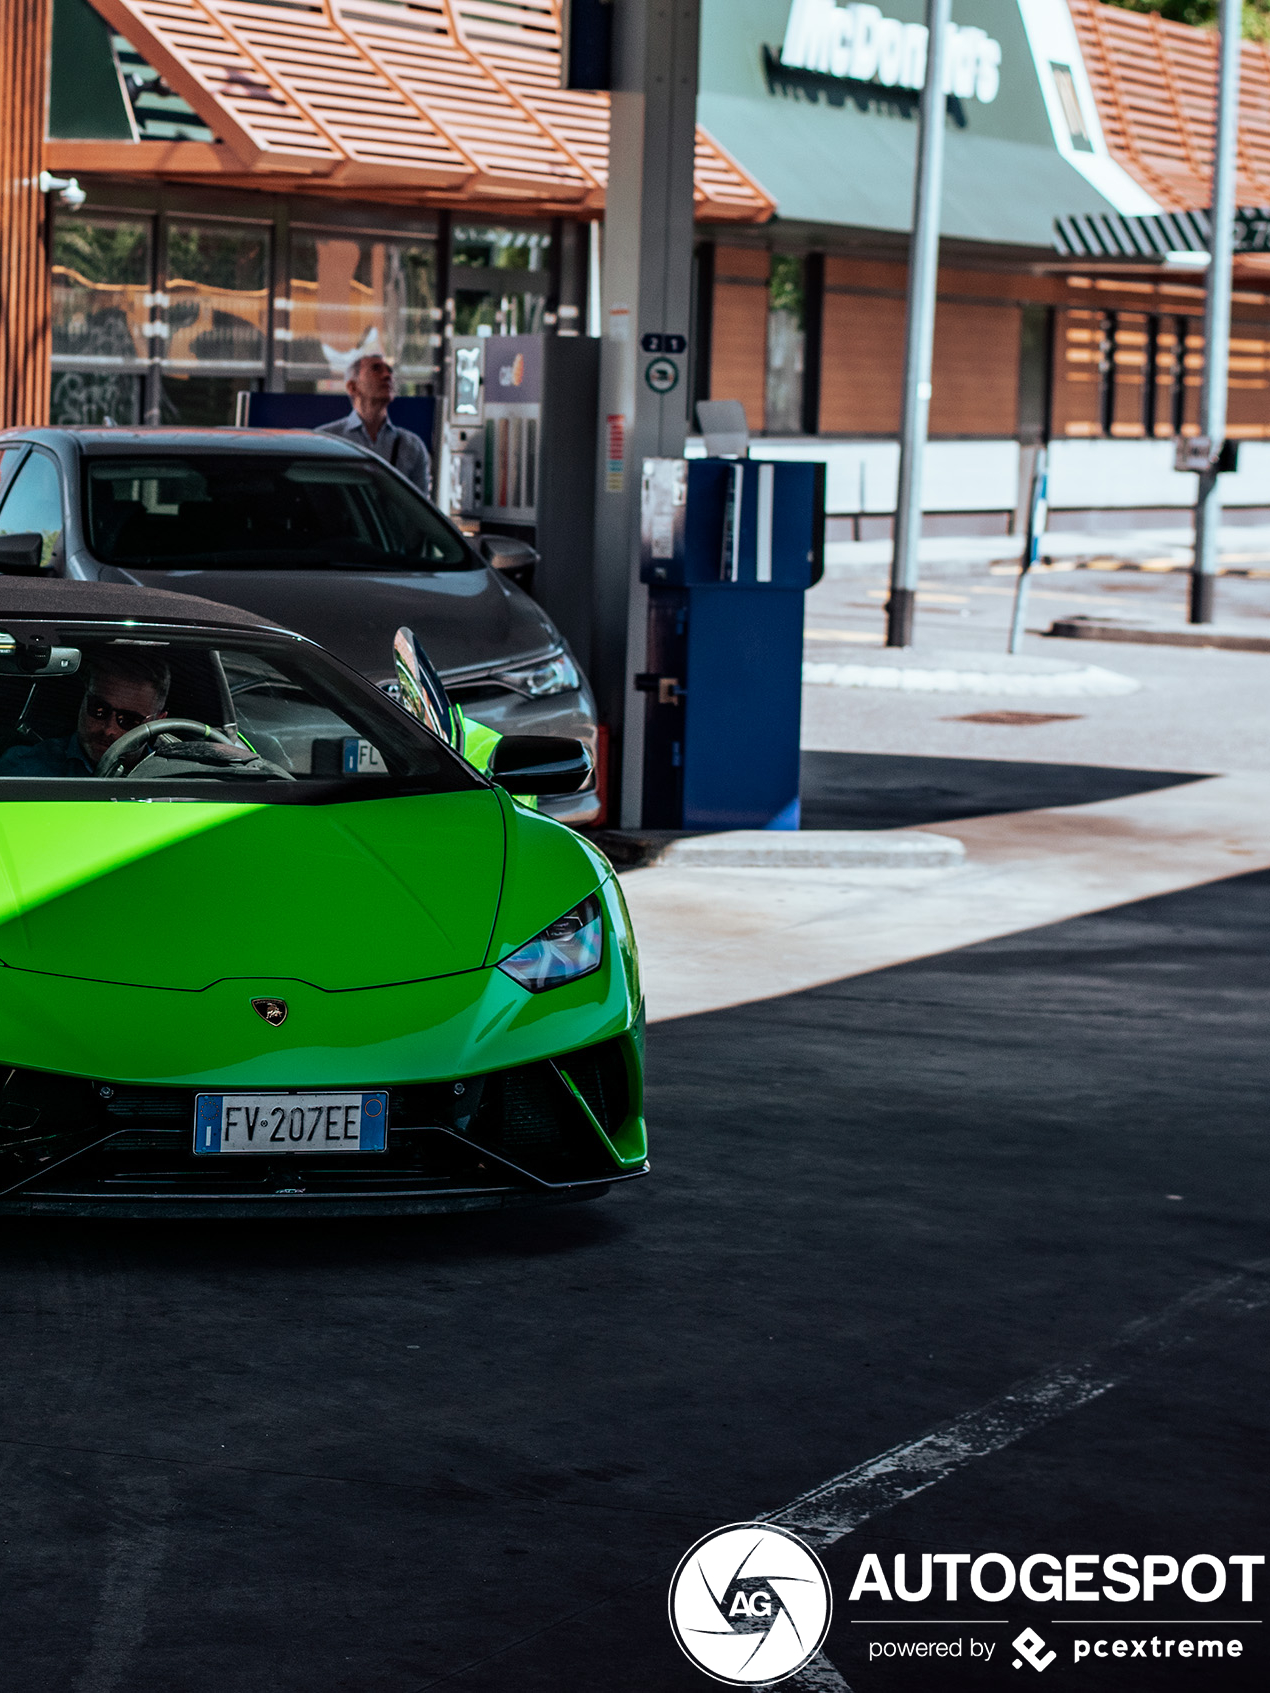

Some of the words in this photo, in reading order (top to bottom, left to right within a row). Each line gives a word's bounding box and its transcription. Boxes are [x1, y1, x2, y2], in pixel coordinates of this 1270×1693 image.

[781, 0, 1001, 104] McDonld's
[649, 336, 658, 350] 2
[670, 336, 678, 350] 1
